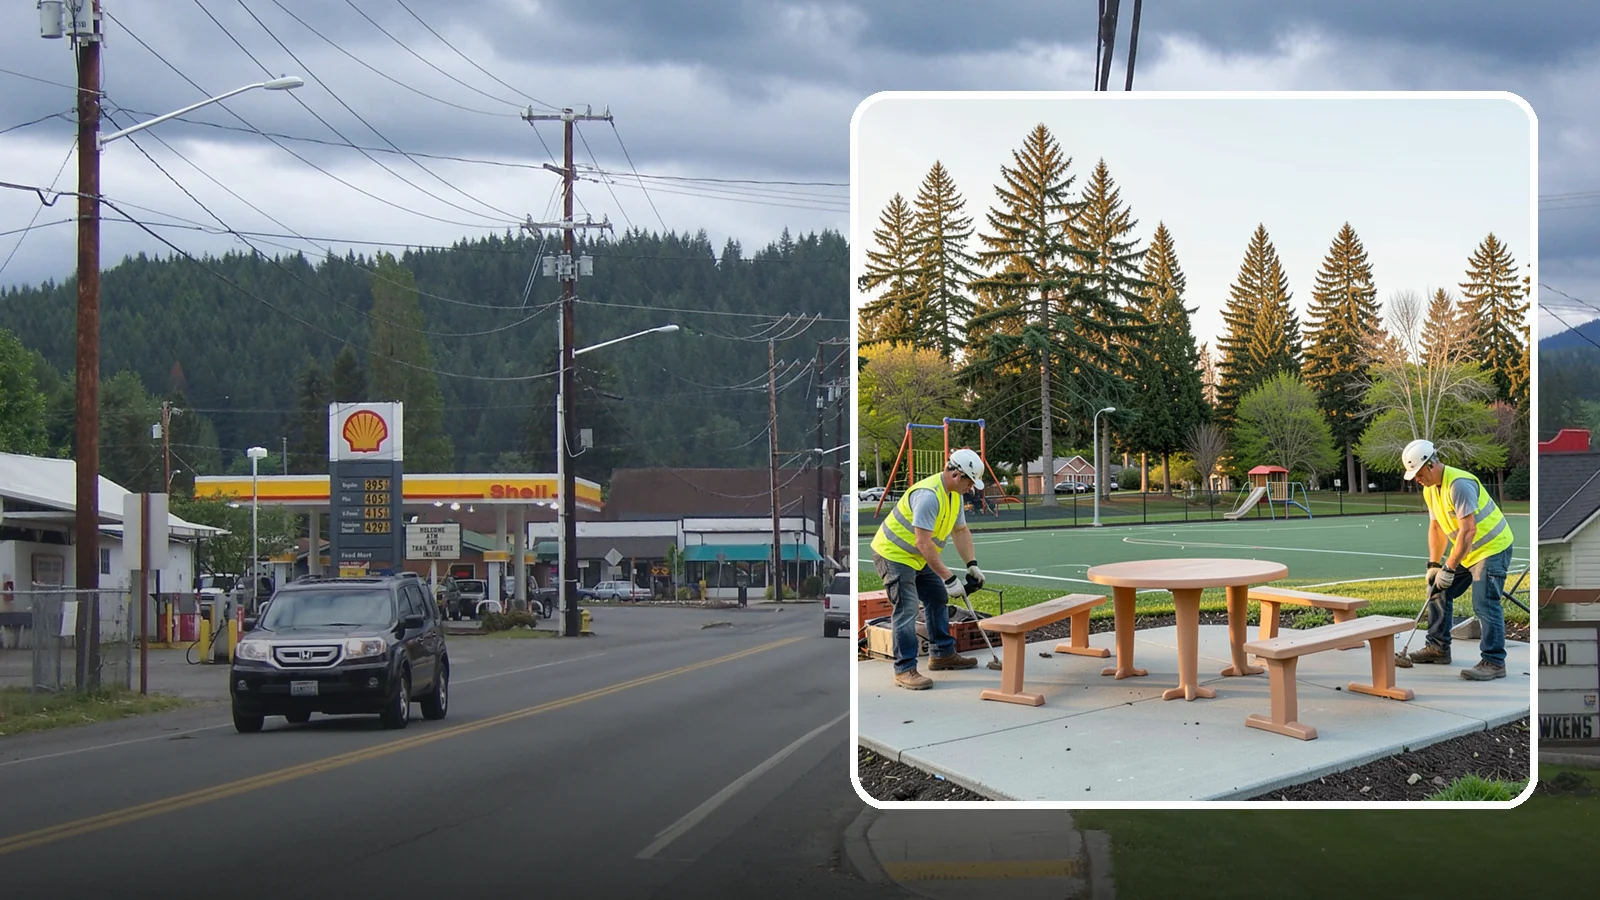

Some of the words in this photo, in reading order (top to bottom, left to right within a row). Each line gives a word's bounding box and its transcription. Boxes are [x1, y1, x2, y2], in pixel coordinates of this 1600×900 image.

[366, 480, 383, 490] 395
[490, 484, 547, 499] Shell
[366, 494, 383, 504] 405
[366, 508, 383, 518] 415
[366, 522, 383, 532] 429
